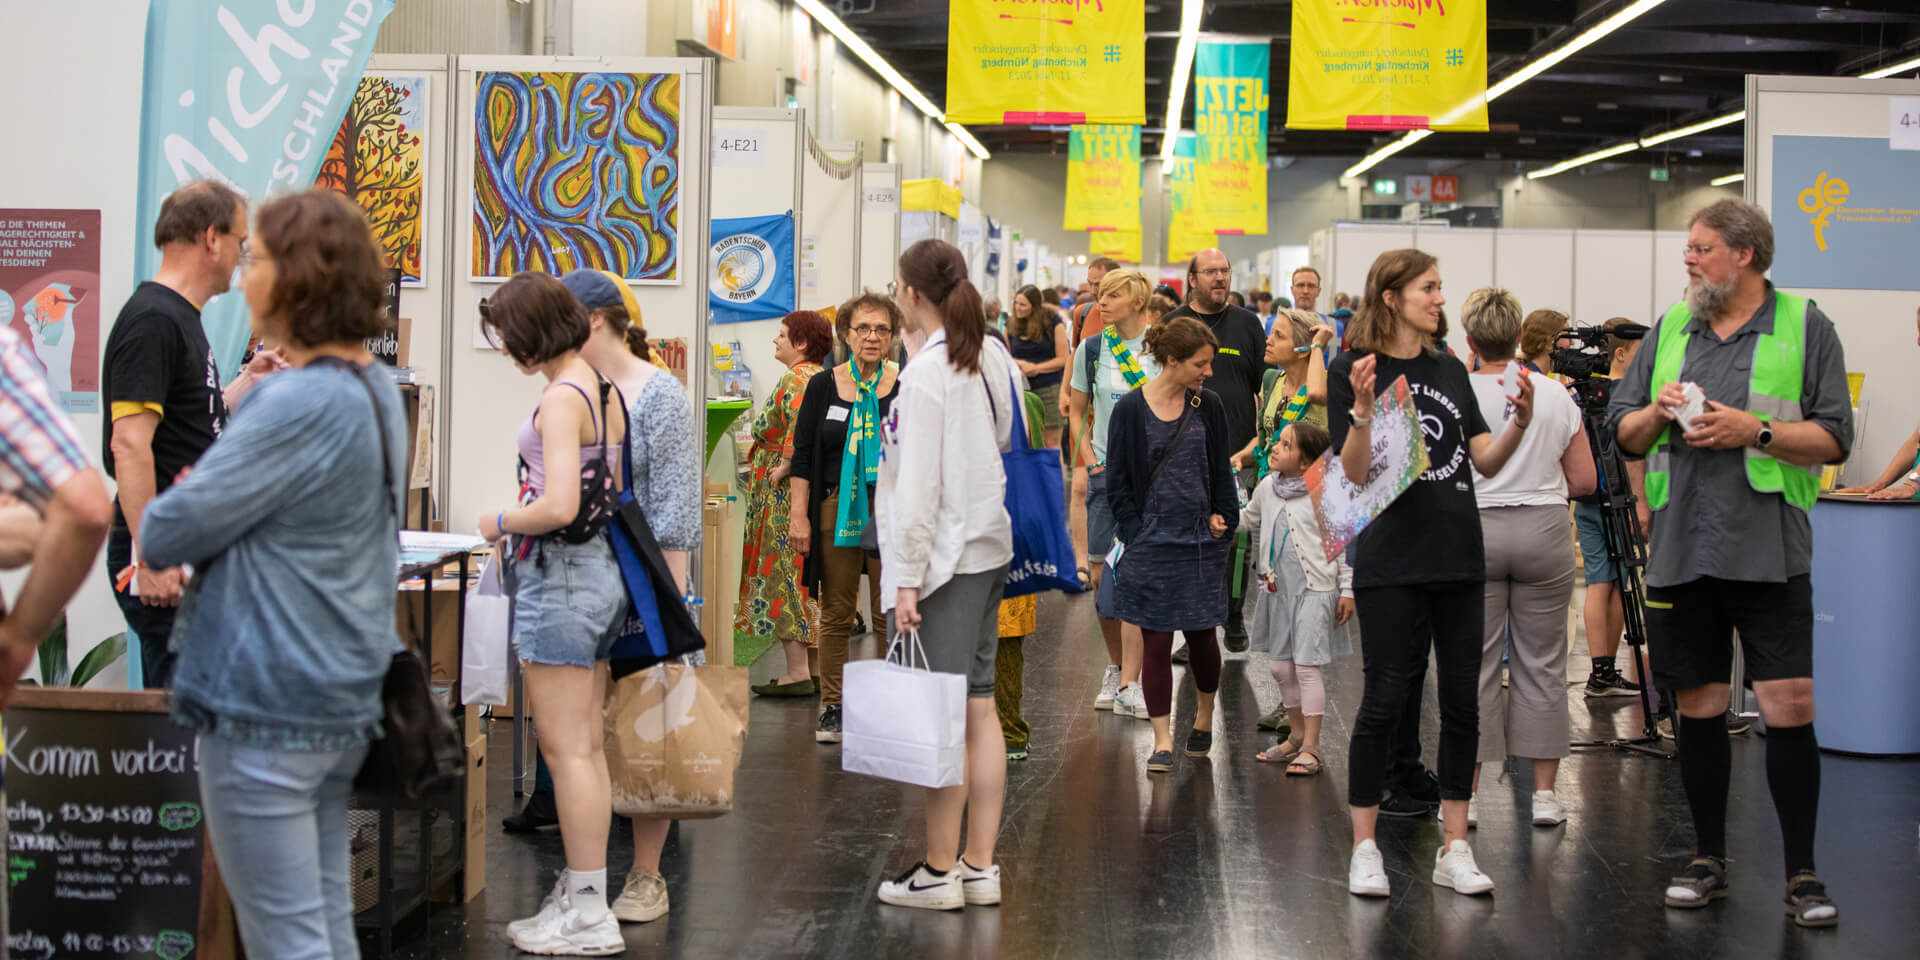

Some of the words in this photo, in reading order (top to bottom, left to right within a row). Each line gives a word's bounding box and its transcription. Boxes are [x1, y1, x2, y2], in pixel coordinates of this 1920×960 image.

[720, 139, 759, 152] 4-E21
[1434, 180, 1456, 198] 4A
[8, 220, 24, 229] DIE
[26, 220, 66, 229] THEMEN
[20, 238, 76, 249] NÄCHSTEN-
[715, 235, 768, 254] RADENTSCHEID
[3, 249, 14, 257] IN
[16, 249, 52, 257] DEINEN
[728, 288, 757, 301] BAYERN
[1423, 384, 1462, 420] LIEBEN
[1436, 444, 1466, 481] SELBST
[3, 726, 101, 778] Komm
